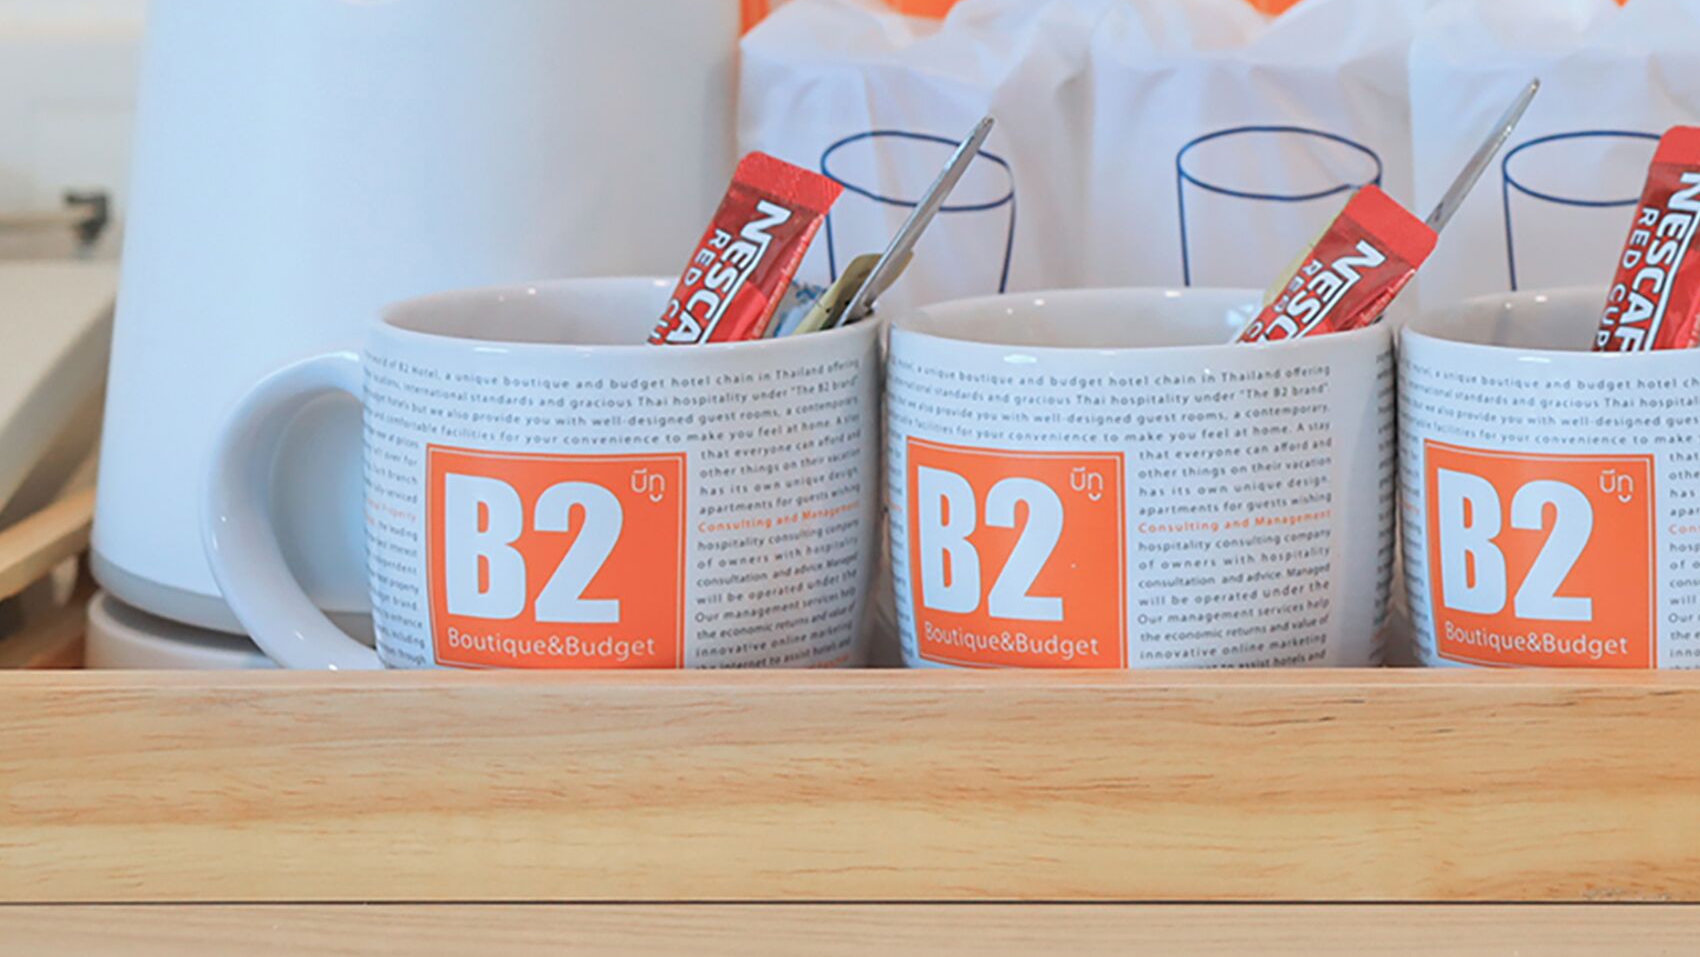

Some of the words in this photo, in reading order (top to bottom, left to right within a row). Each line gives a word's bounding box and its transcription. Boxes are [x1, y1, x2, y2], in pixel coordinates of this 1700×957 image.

[1623, 206, 1660, 269] RED
[685, 228, 732, 286] RED
[1257, 239, 1387, 342] NESC
[503, 375, 569, 390] boutique
[576, 379, 603, 389] and
[610, 378, 664, 391] budget
[671, 375, 710, 387] hotel
[715, 373, 753, 385] chain
[959, 370, 1013, 386] boutique
[1020, 375, 1044, 386] and
[1050, 376, 1101, 389] budget
[1109, 375, 1148, 387] hotel
[1154, 375, 1195, 386] chain
[1221, 368, 1280, 382] Thailand
[1480, 374, 1539, 389] boutique
[1545, 379, 1570, 390] and
[1576, 379, 1630, 392] budget
[1637, 378, 1677, 389] hotel
[471, 392, 532, 406] standards
[540, 397, 564, 407] and
[570, 399, 631, 410] gracious
[638, 396, 667, 407] Thai
[673, 392, 747, 407] hospitality
[751, 388, 786, 400] under
[1014, 395, 1070, 406] gracious
[1077, 394, 1104, 405] Thai
[1110, 393, 1188, 406] hospitality
[1193, 391, 1234, 402] under
[1540, 398, 1598, 409] gracious
[1604, 397, 1634, 408] Thai
[525, 416, 550, 426] you
[555, 415, 591, 426] with
[698, 411, 735, 426] guest
[1002, 412, 1029, 422] with
[1136, 412, 1175, 425] guest
[1501, 414, 1521, 424] you
[1527, 415, 1555, 425] with
[525, 434, 557, 445] your
[563, 435, 659, 444] convenience
[665, 433, 681, 443] to
[686, 430, 723, 442] make
[729, 429, 753, 441] you
[758, 424, 781, 436] feel
[977, 429, 1003, 439] your
[1009, 432, 1096, 442] convenience
[1123, 431, 1162, 442] make
[1168, 431, 1195, 443] you
[1201, 427, 1228, 438] feel
[1535, 435, 1625, 445] convenience
[1653, 433, 1692, 444] make
[700, 448, 729, 459] that
[733, 443, 792, 457] everyone
[796, 439, 814, 450] can
[1139, 449, 1169, 460] that
[1175, 447, 1240, 459] everyone
[1245, 445, 1267, 455] can
[1669, 450, 1699, 461] that
[699, 466, 735, 478] other
[740, 462, 779, 474] things
[1138, 467, 1176, 478] other
[1181, 466, 1225, 478] things
[1250, 461, 1280, 472] their
[700, 485, 724, 495] has
[730, 483, 748, 494] its
[754, 481, 780, 492] own
[786, 473, 825, 488] unique
[1138, 486, 1164, 497] has
[1170, 485, 1190, 495] its
[1196, 484, 1227, 495] own
[1233, 480, 1280, 492] unique
[1669, 488, 1695, 498] has
[699, 499, 772, 516] apartments
[776, 496, 792, 507] for
[1138, 502, 1218, 517] apartments
[1222, 500, 1242, 511] for
[1245, 496, 1287, 512] guests
[698, 518, 772, 532] Consulting
[1137, 520, 1219, 534] Consulting
[1223, 517, 1249, 529] and
[445, 471, 624, 624] B2
[917, 464, 1065, 623] B2
[1437, 466, 1594, 622] B2
[447, 627, 656, 661] Boutique&Budget
[924, 621, 1100, 660] Boutique&Budget
[1444, 620, 1629, 660] Boutique&Budget
